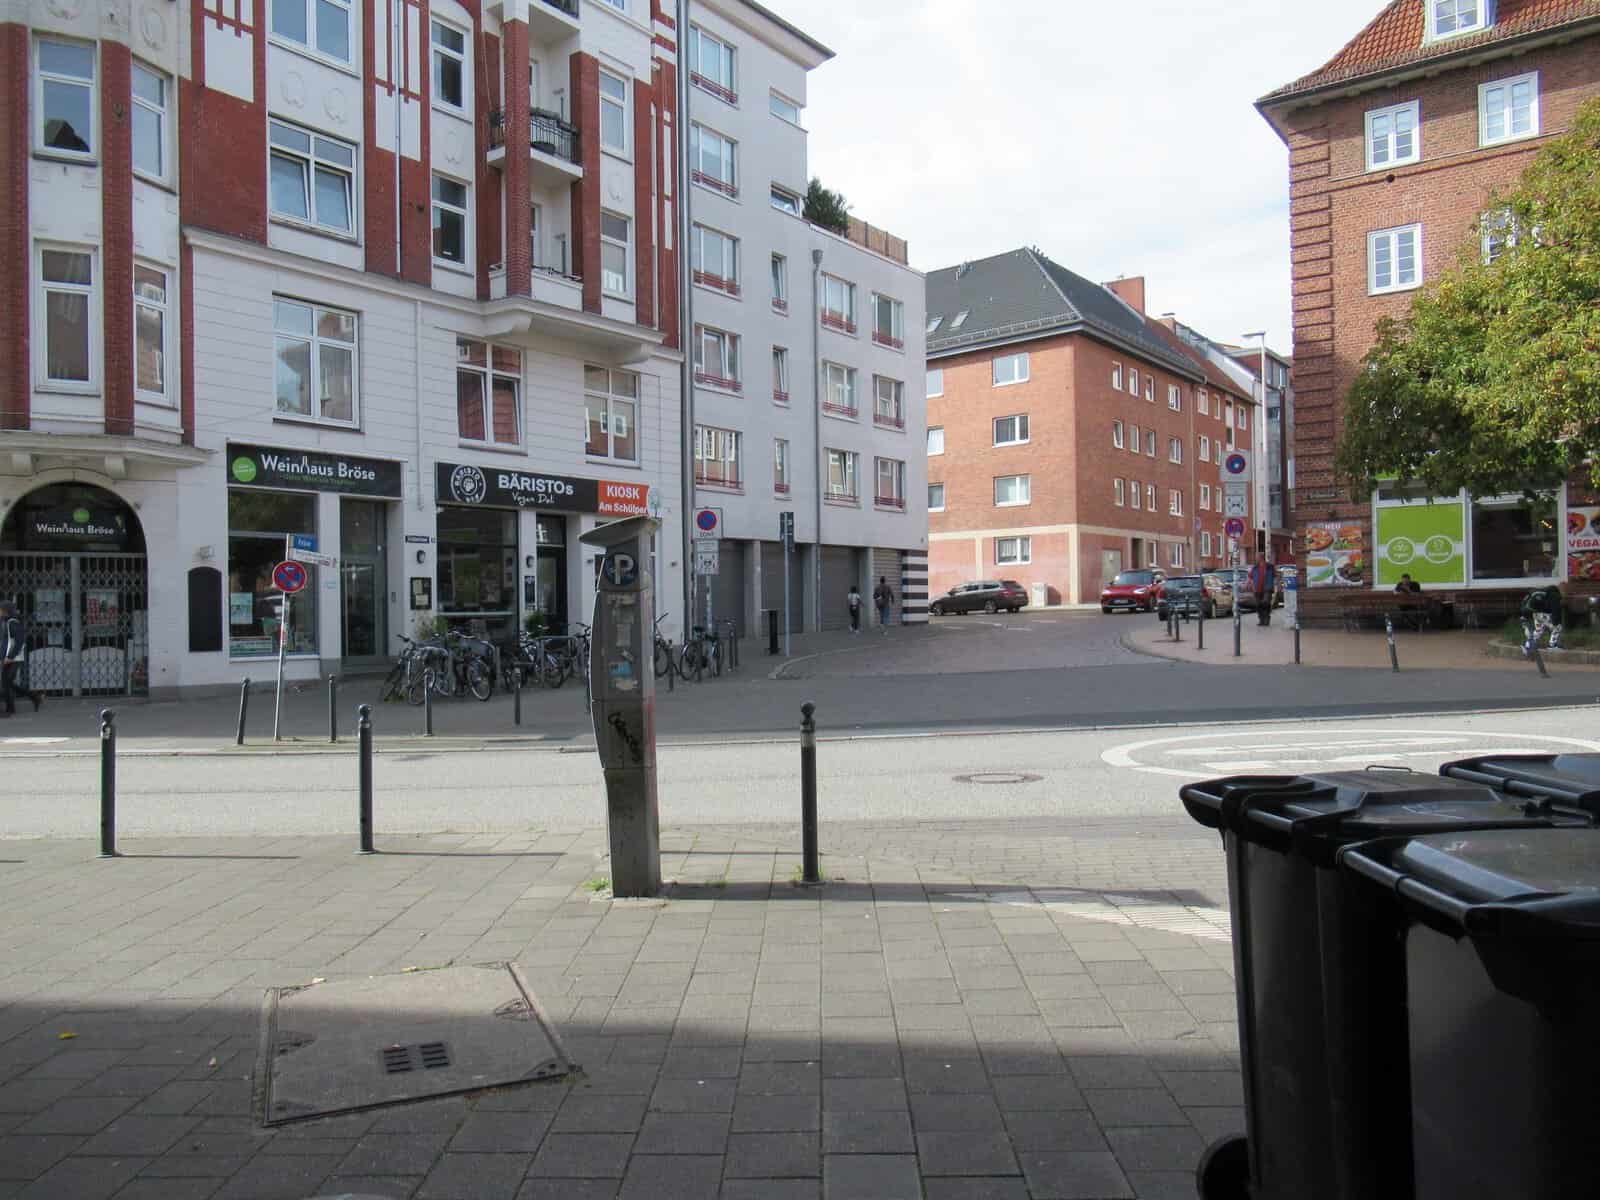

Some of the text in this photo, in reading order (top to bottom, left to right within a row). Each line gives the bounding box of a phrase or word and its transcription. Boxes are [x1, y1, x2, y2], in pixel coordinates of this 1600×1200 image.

[260, 454, 333, 476] Weinhaus
[338, 462, 375, 480] Bröse
[607, 485, 640, 499] KIOSK
[599, 502, 612, 512] Am
[36, 522, 115, 535] Weinhaus Bröse
[613, 554, 635, 585] P
